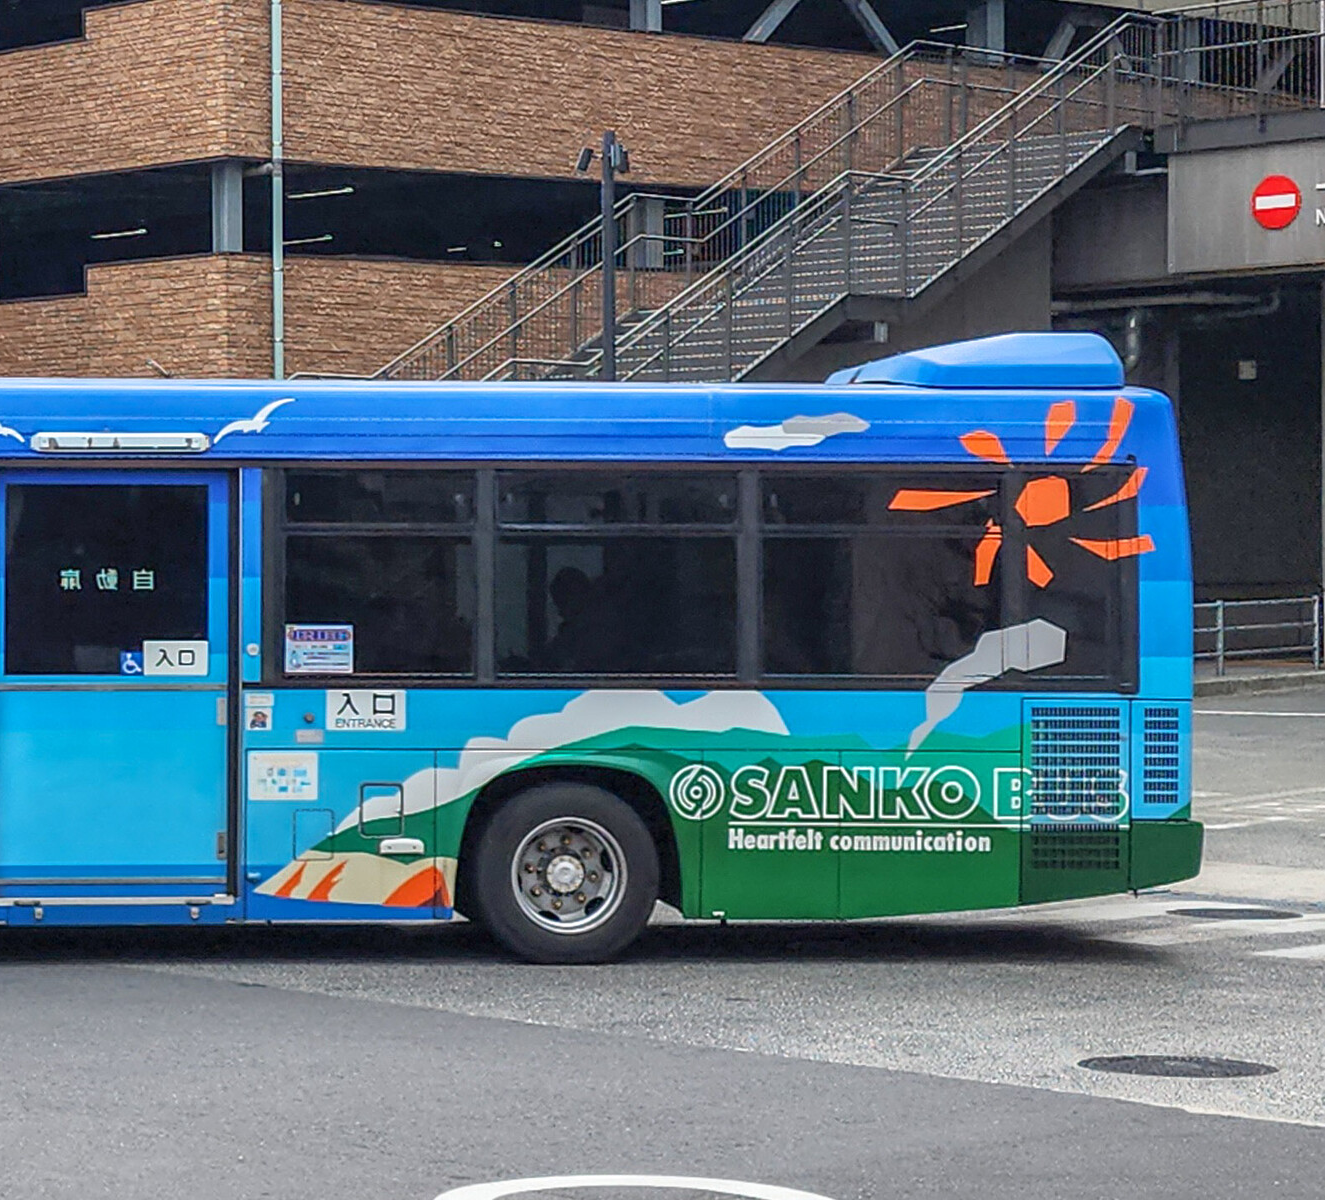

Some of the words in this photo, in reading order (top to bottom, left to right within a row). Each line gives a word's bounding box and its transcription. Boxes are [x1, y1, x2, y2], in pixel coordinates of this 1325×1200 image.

[155, 649, 195, 667] 入口
[337, 693, 396, 715] 入口
[335, 719, 397, 729] ENTRANCE
[729, 765, 981, 820] SANKO
[728, 828, 823, 850] Heartfelt
[829, 831, 991, 852] communication
